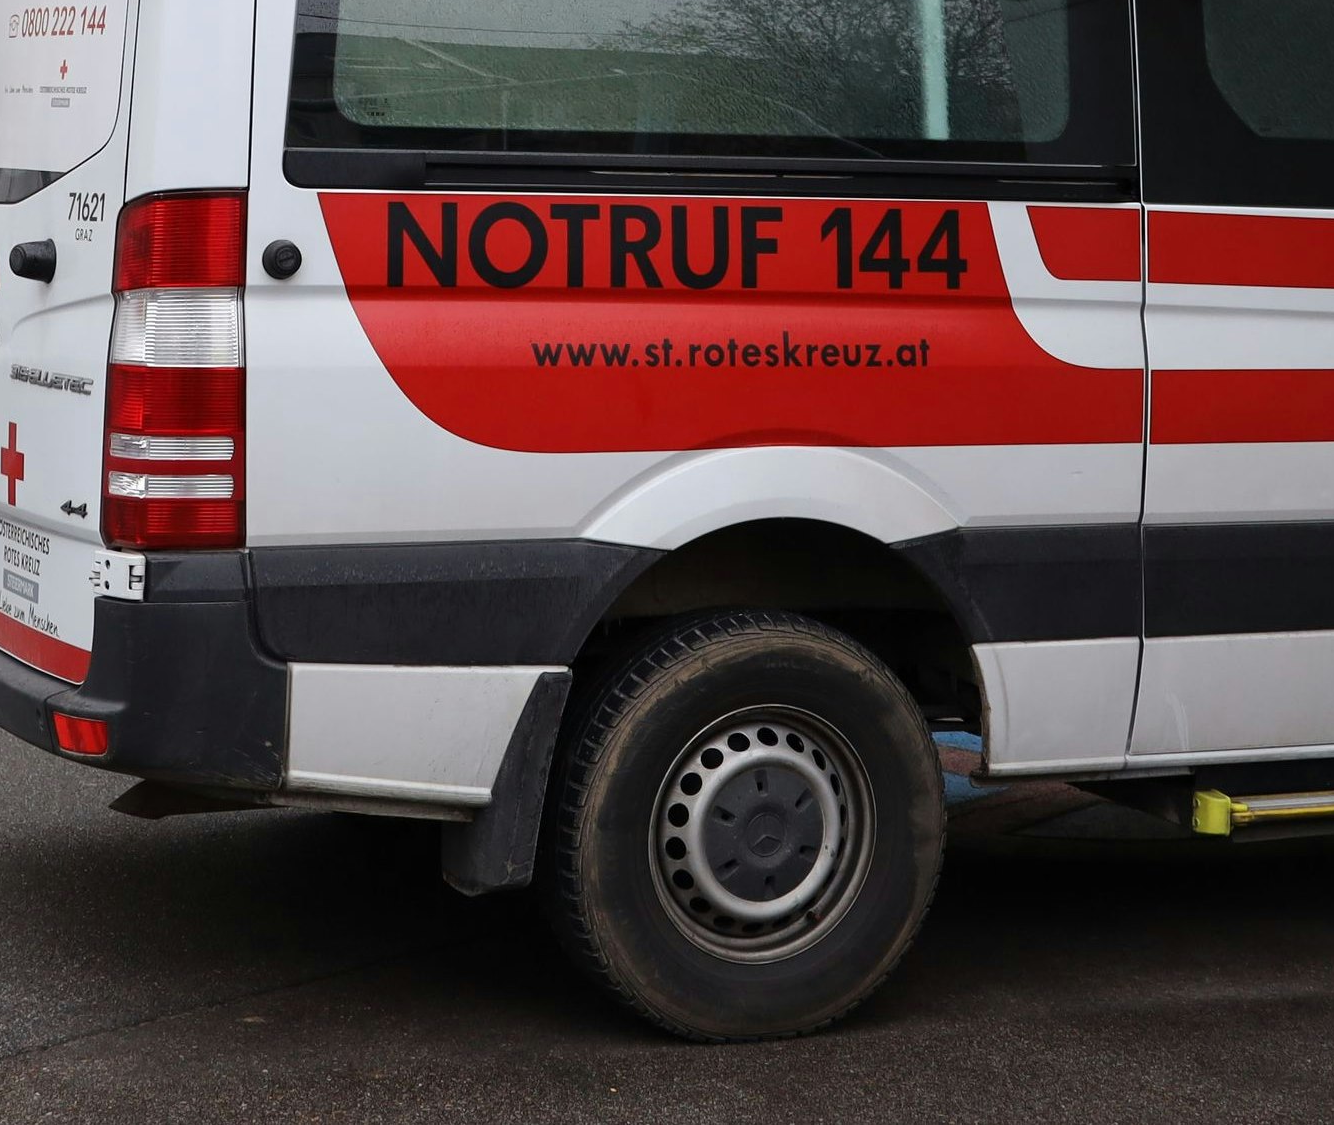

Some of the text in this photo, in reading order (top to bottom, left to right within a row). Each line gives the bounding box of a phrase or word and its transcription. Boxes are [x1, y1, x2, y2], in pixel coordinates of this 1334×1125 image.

[21, 5, 107, 38] 0800 222 144
[68, 192, 105, 222] 71621
[387, 200, 968, 290] NOTRUF 144
[531, 331, 930, 368] www.st.roteskreuz.at
[3, 545, 41, 576] ROTES KREUZ
[13, 605, 25, 623] zum
